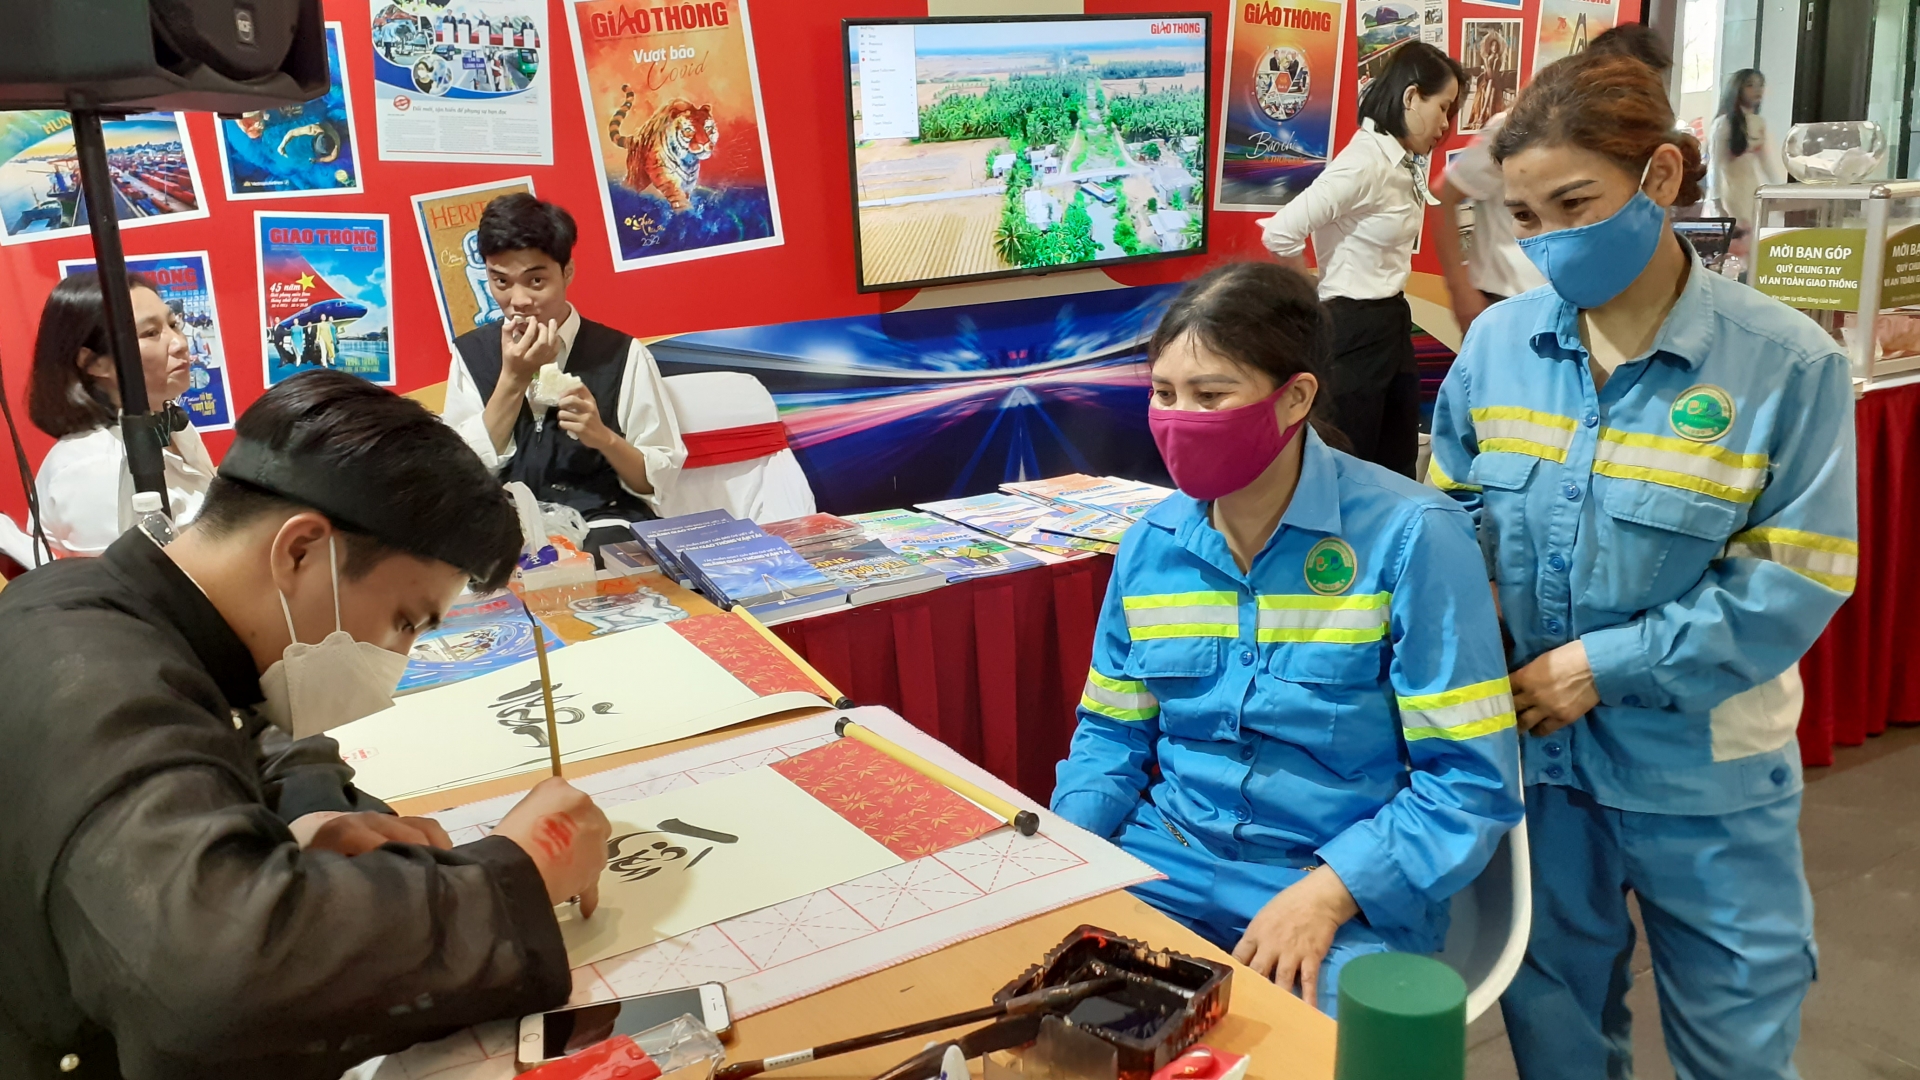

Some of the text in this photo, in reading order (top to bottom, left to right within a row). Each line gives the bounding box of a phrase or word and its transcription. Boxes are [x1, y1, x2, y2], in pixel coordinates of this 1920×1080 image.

[651, 2, 729, 32] THÔNG
[1284, 8, 1331, 32] THÔNG
[633, 44, 695, 65] Vượt bão
[647, 50, 709, 91] Covid
[270, 228, 377, 245] GIAO THÔNG
[1770, 244, 1852, 260] MỜI BẠN GÓP
[1776, 264, 1842, 275] QUỸ CHUNG TAY
[270, 283, 282, 292] 45
[1782, 276, 1804, 286] TOÀN
[1806, 278, 1827, 288] GIAO
[1828, 279, 1858, 289] THÔNG
